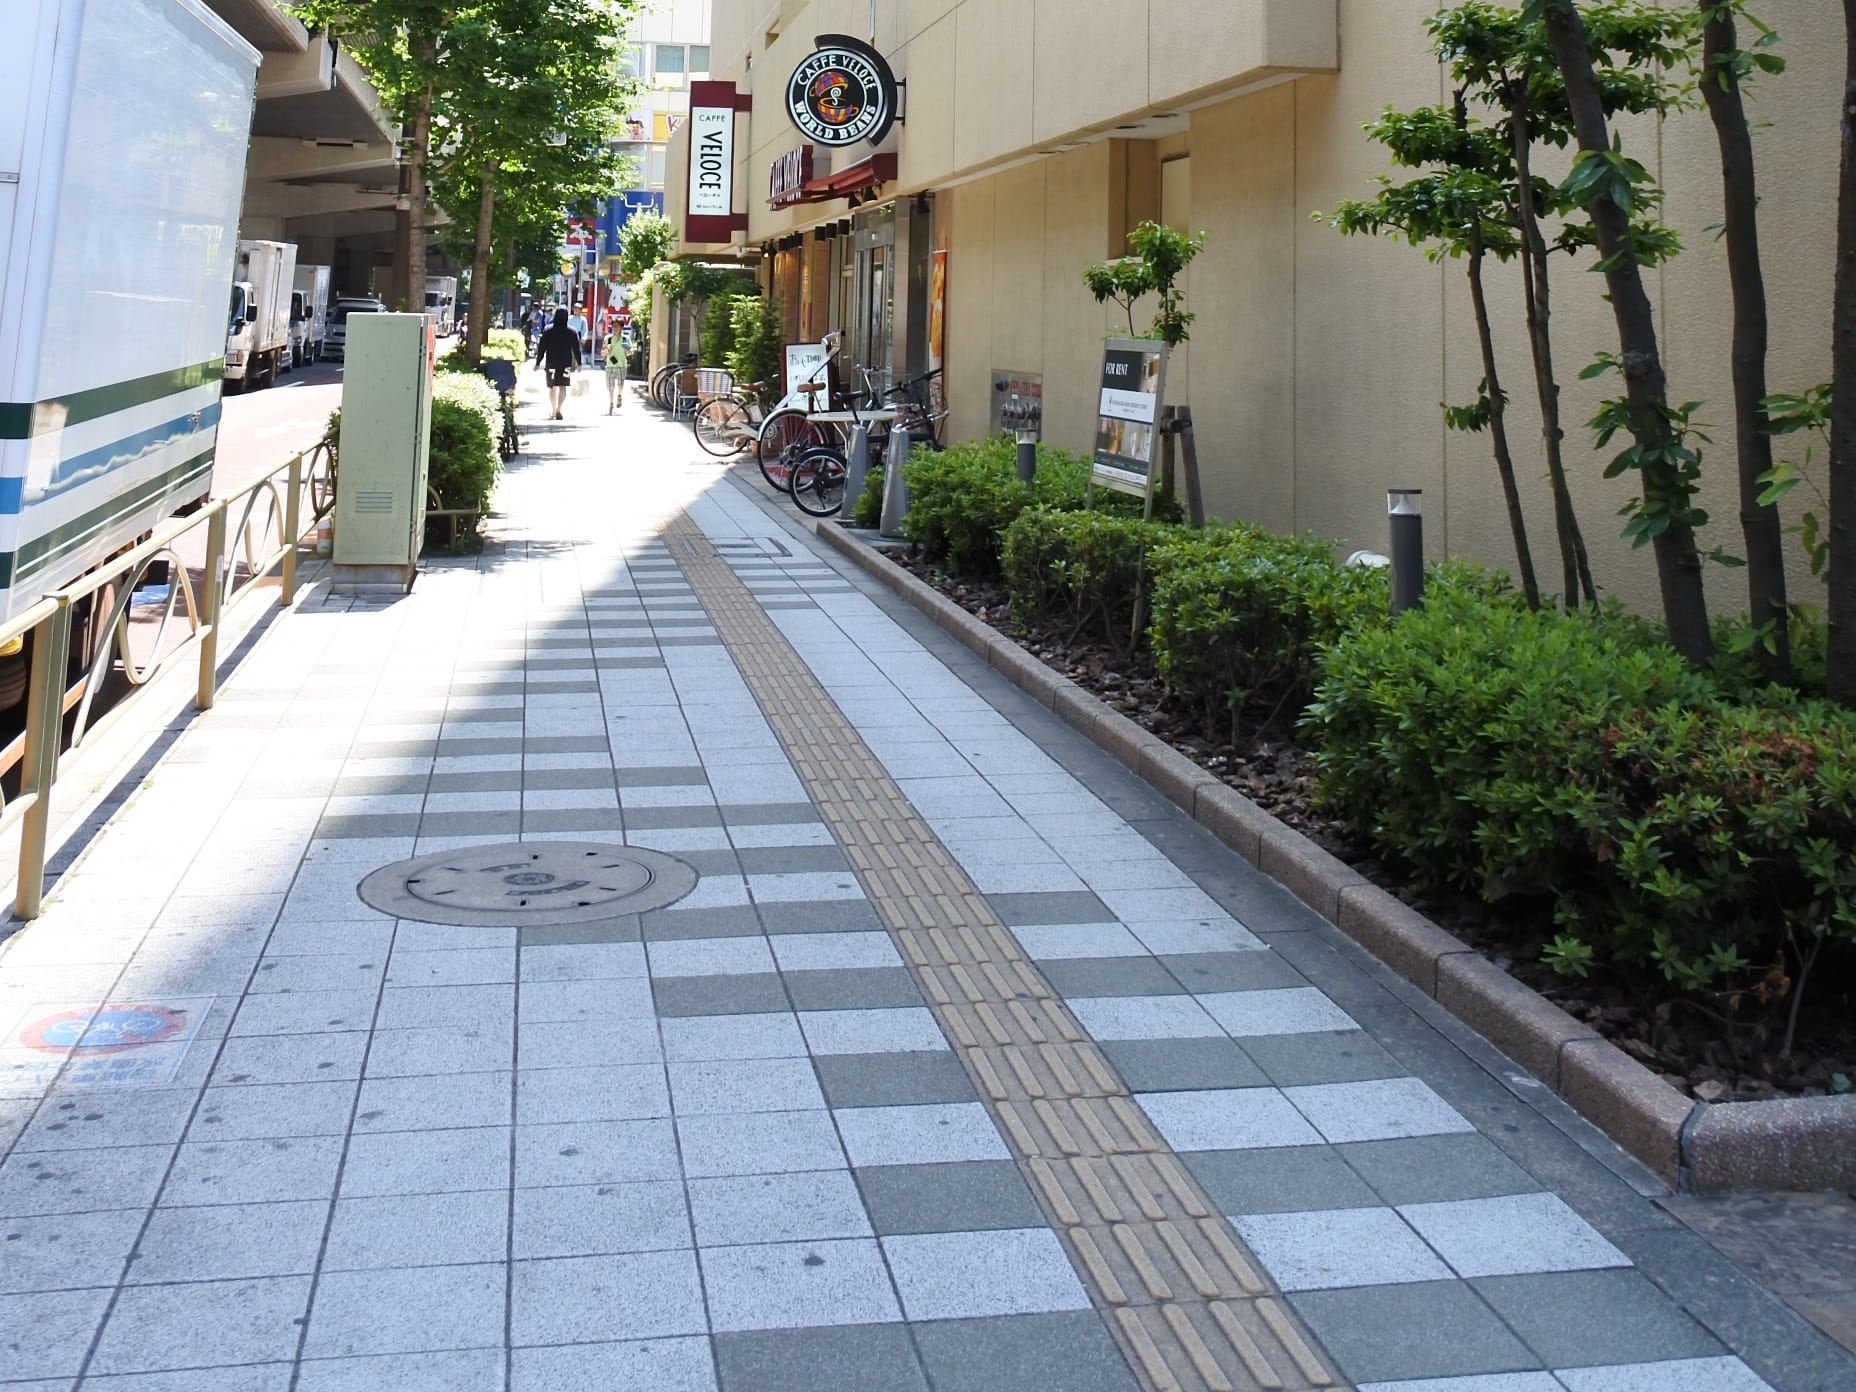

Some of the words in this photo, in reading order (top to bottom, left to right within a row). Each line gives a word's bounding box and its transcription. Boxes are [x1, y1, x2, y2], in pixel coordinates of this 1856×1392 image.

[797, 55, 837, 85] CAFFE
[842, 55, 877, 90] VELOCE
[698, 114, 726, 123] CAFFE
[794, 100, 834, 139] WORLD
[838, 104, 876, 139] BEANS
[699, 130, 723, 190] VELOCE
[1105, 362, 1116, 375] FOR
[1115, 363, 1128, 376] RENT
